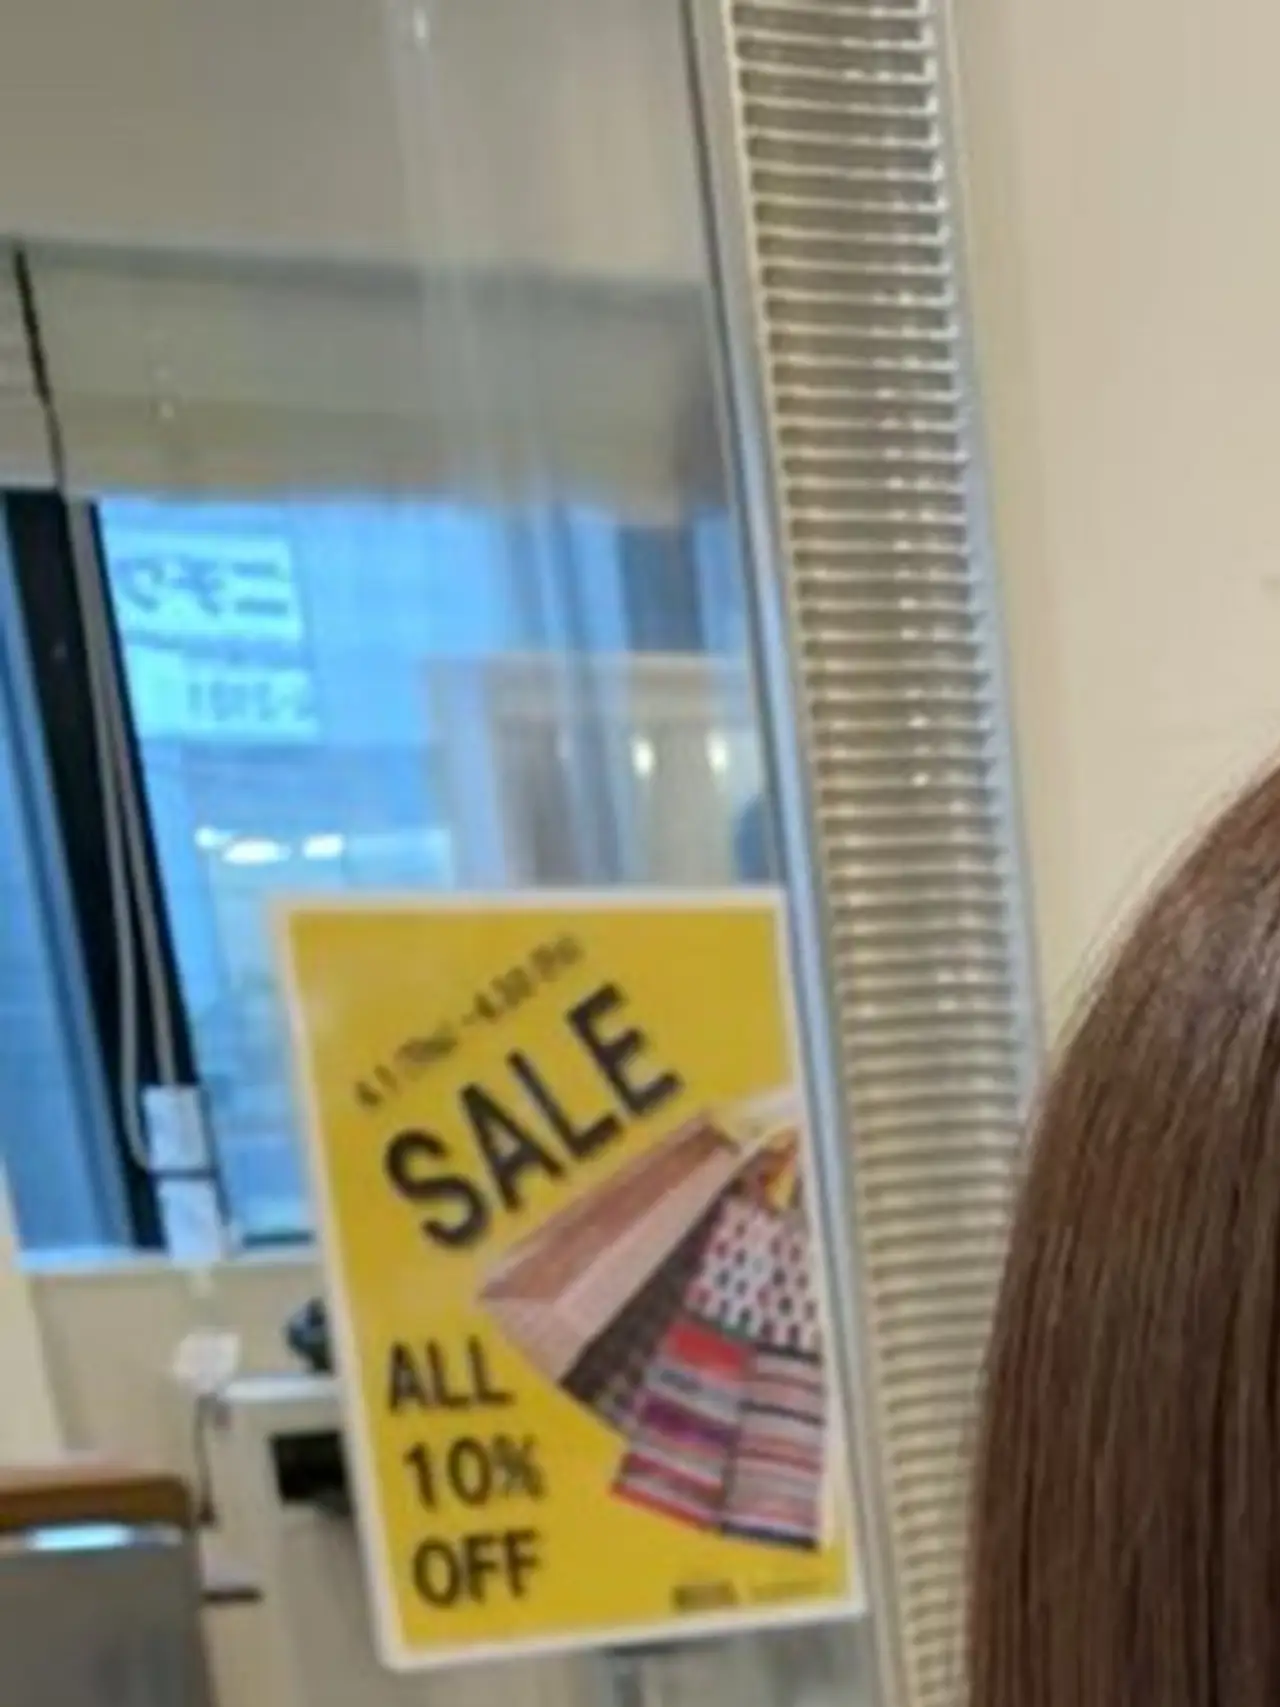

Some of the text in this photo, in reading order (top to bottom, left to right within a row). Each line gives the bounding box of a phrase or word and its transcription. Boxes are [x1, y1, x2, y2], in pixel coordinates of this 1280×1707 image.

[384, 981, 686, 1248] SALE
[388, 1333, 516, 1415] ALL
[402, 1432, 548, 1512] 10%
[412, 1528, 541, 1608] OFF
